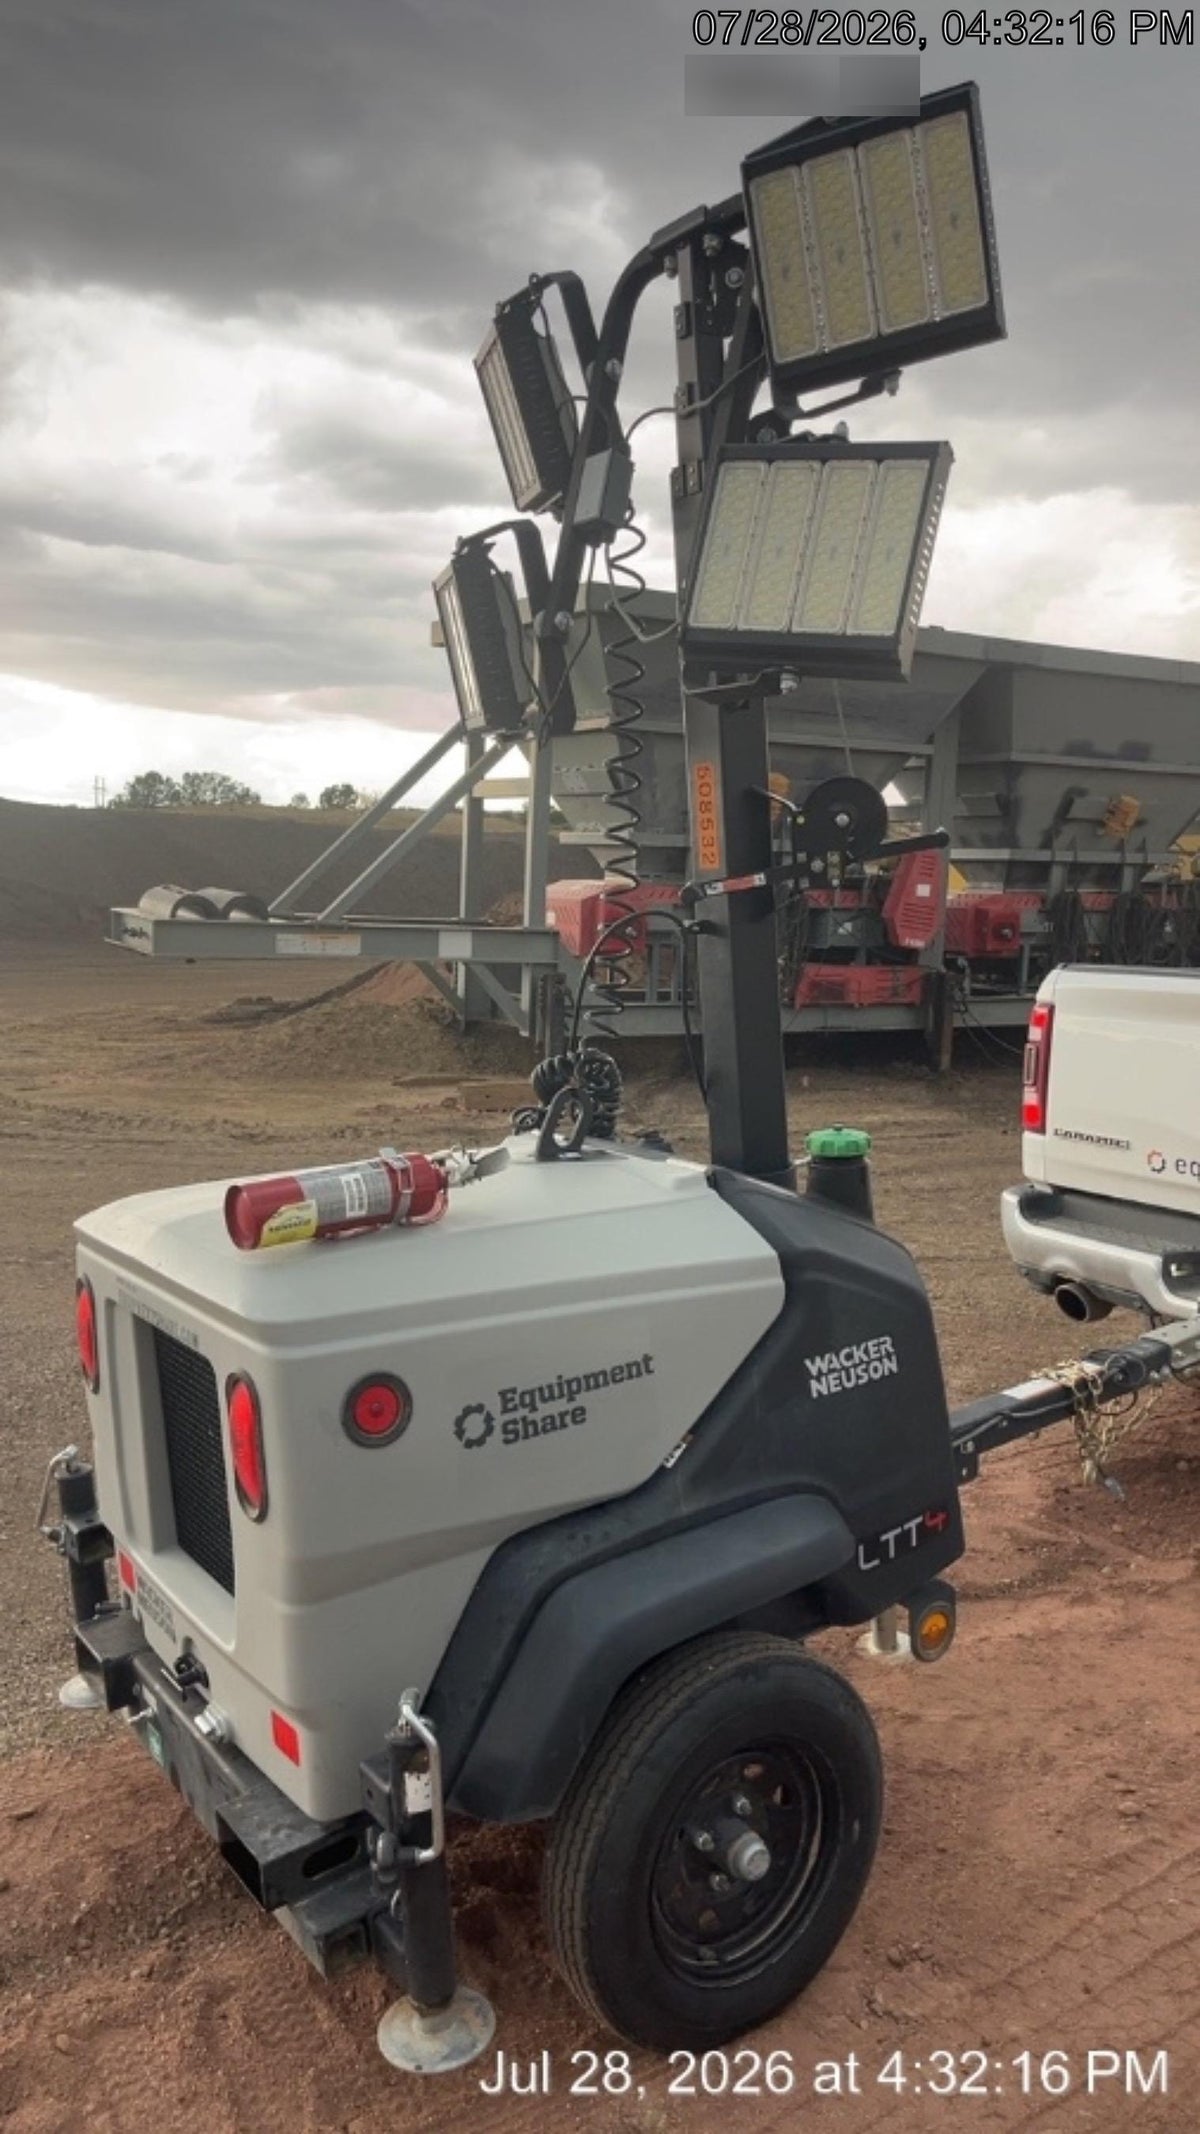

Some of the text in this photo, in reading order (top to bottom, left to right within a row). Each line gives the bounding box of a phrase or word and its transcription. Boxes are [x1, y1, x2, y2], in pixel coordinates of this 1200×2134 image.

[803, 1336, 895, 1377] WACKER
[810, 1353, 898, 1399] NEUSON
[499, 1353, 655, 1415] Equipment
[501, 1404, 588, 1445] Share
[858, 1511, 948, 1571] LTT4
